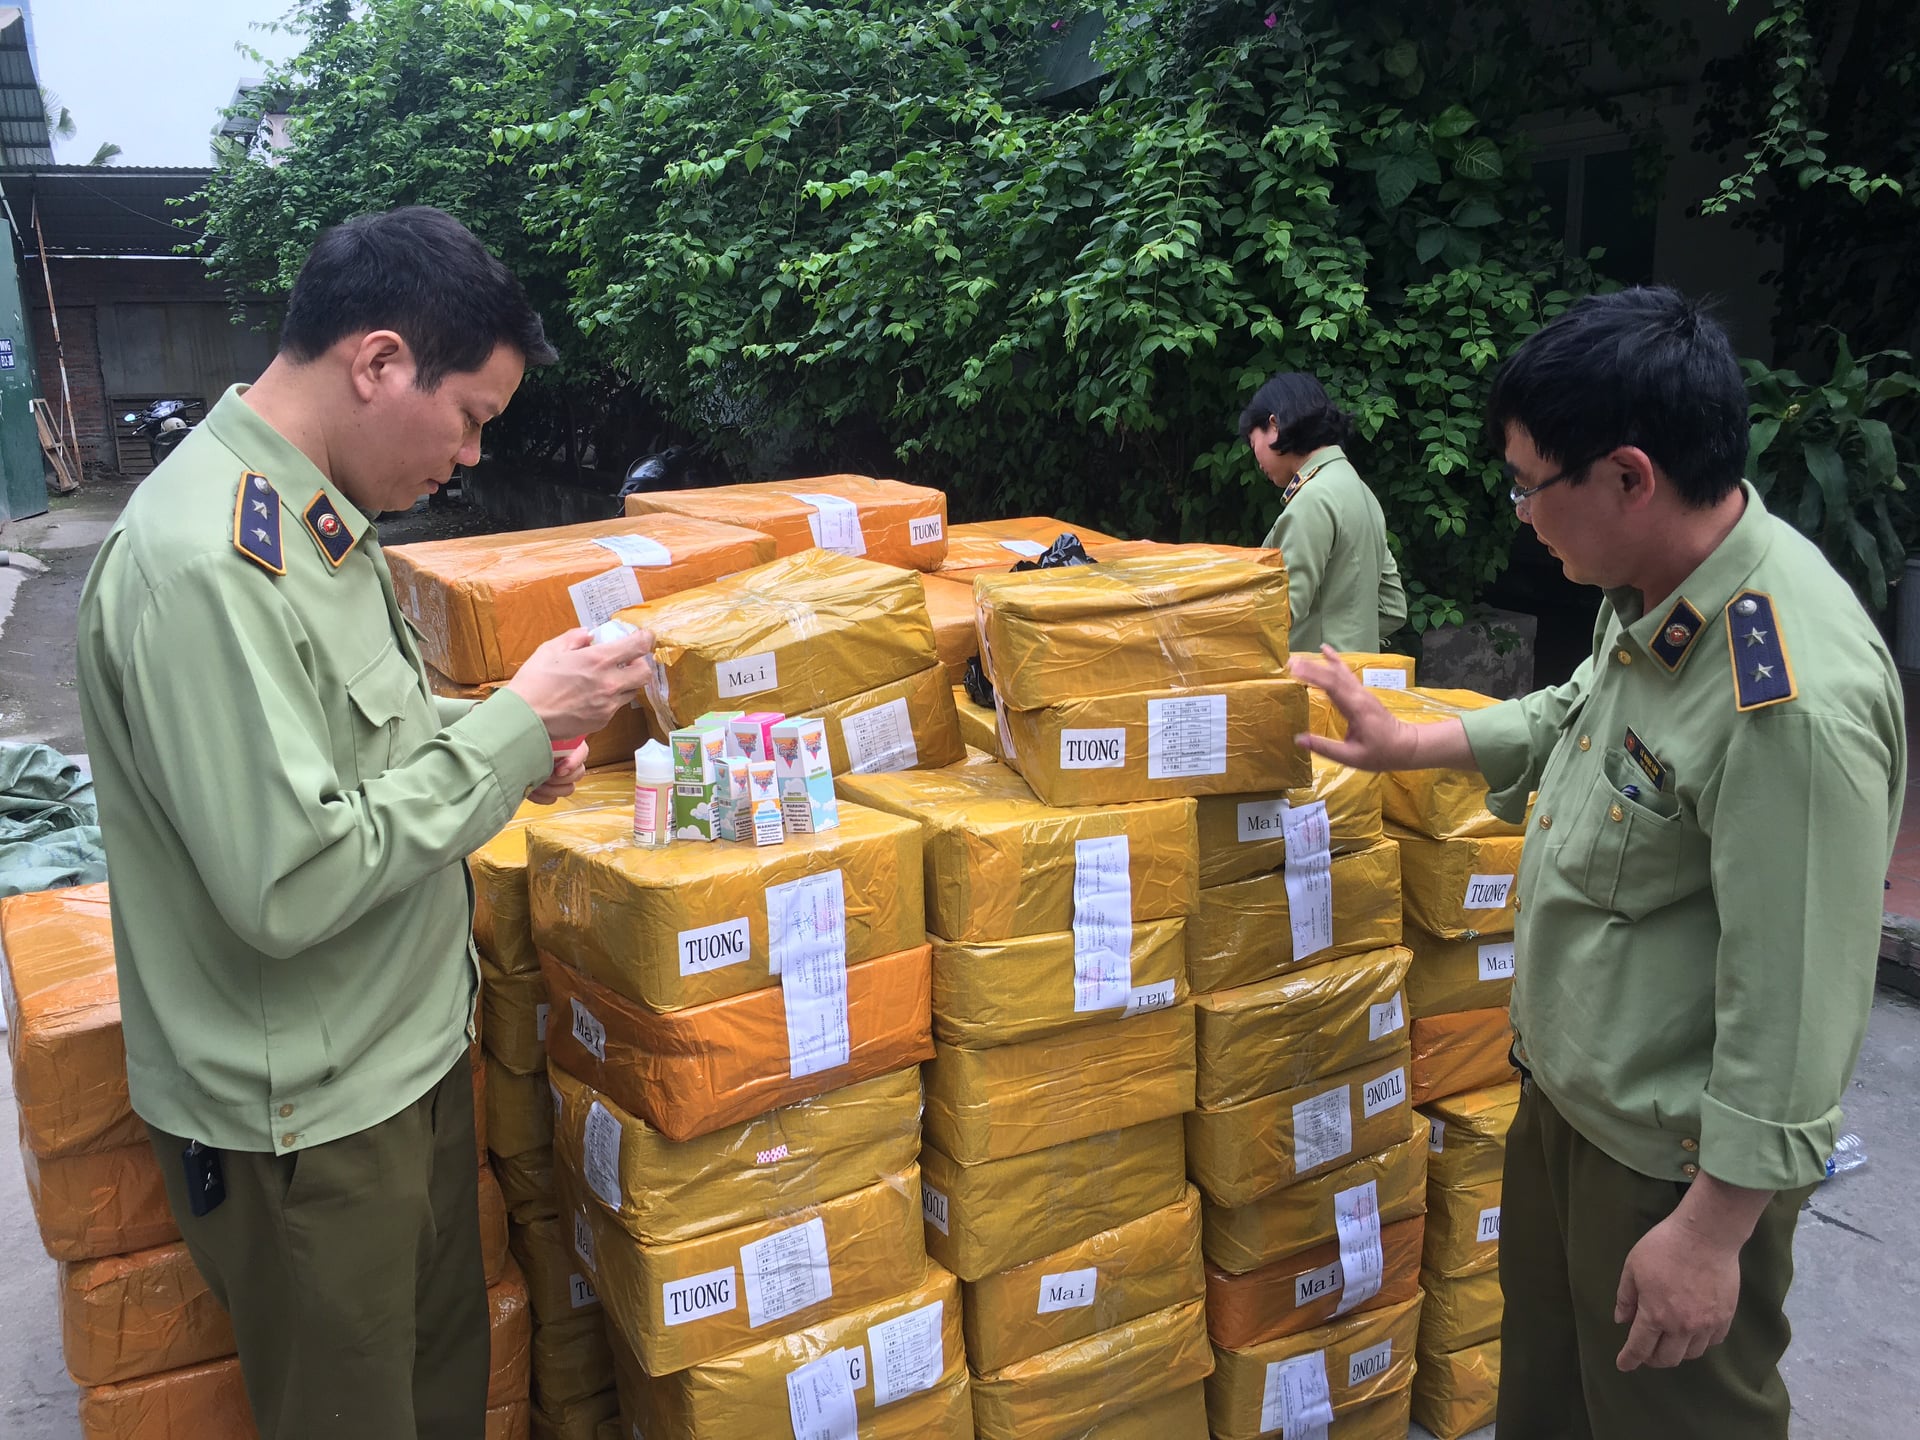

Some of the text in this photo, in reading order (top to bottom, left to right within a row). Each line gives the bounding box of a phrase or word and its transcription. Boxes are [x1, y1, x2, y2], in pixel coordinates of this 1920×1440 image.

[912, 521, 940, 541] TUONG
[728, 666, 767, 688] Mai
[1066, 739, 1119, 762] TUONG
[1247, 813, 1281, 831] Mai
[1471, 884, 1506, 903] TUONG
[685, 929, 744, 964] TUONG
[1486, 955, 1514, 971] Mai
[576, 1010, 601, 1053] Mai
[1367, 1075, 1402, 1107] TUONG
[1048, 1283, 1086, 1303] Mai
[1301, 1270, 1337, 1300] Mai
[670, 1279, 730, 1315] TUONG
[1352, 1351, 1386, 1381] TUONG
